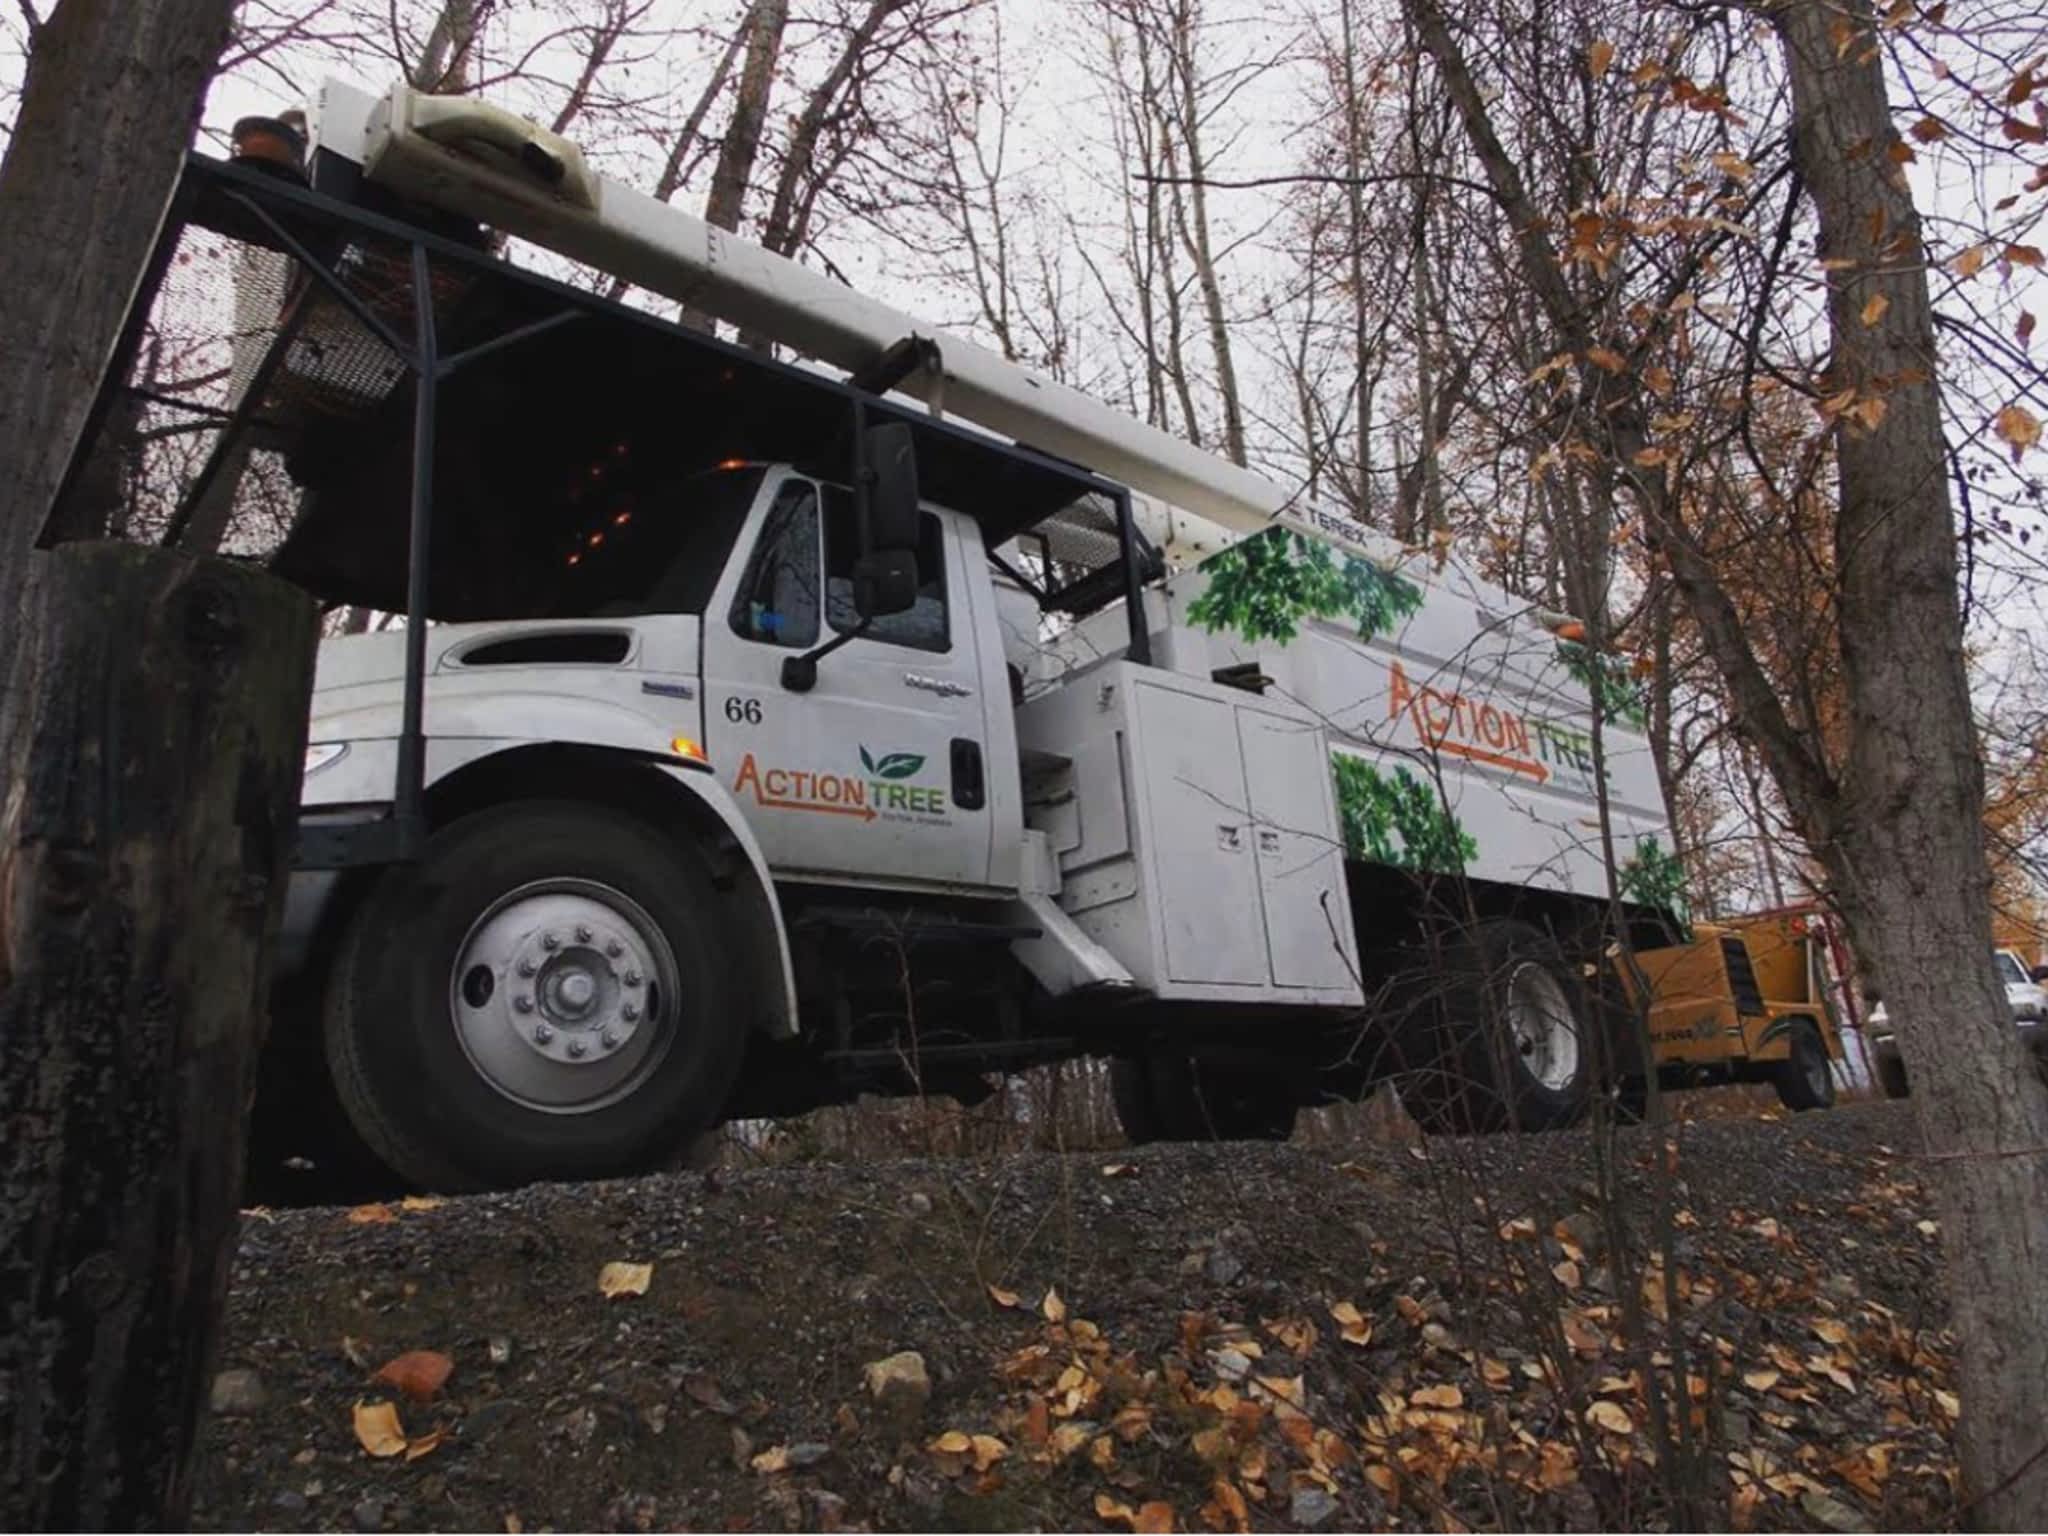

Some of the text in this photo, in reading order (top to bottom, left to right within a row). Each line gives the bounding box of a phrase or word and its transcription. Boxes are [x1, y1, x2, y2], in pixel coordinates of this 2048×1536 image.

[1305, 505, 1368, 549] TEREX
[725, 696, 763, 725] 66
[1387, 658, 1611, 780] ACTIONTRE
